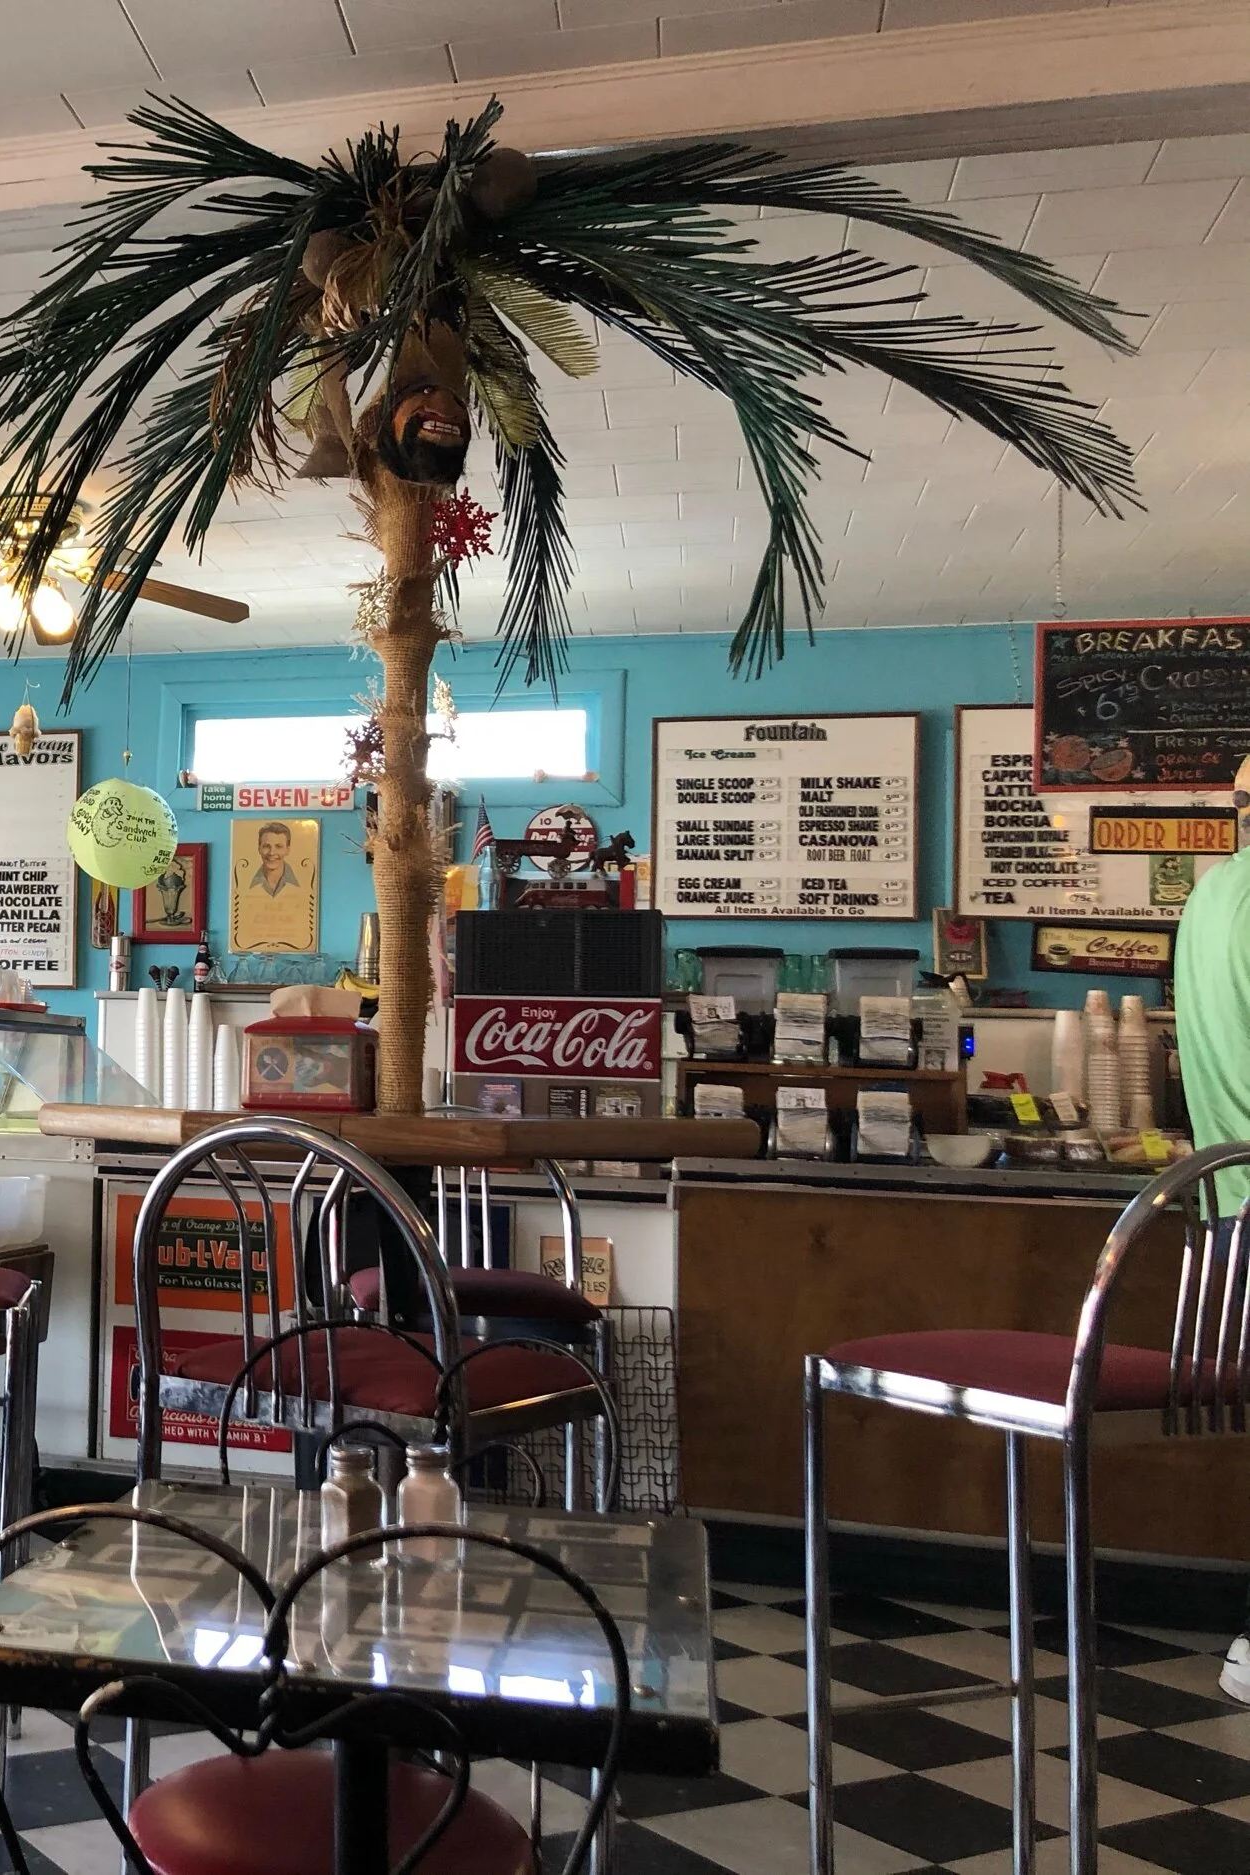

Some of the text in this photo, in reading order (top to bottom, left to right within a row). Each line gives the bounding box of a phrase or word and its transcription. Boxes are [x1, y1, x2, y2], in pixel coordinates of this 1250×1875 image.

[1076, 628, 1247, 653] BREAKFAS
[744, 722, 827, 741] Fountain
[31, 740, 75, 752] ream
[684, 749, 757, 759] Ice Cream
[991, 754, 1032, 767] ESPR
[982, 770, 1032, 782] CAPPUC
[203, 785, 226, 793] take
[676, 778, 715, 790] SINGLE
[718, 777, 754, 789] SCOOP
[800, 777, 832, 789] MILK
[837, 777, 881, 789] SHAKE
[203, 793, 232, 801] home
[238, 788, 351, 808] SEVEN-UP
[678, 792, 718, 803] DOUBLE
[721, 792, 755, 803] SCOOP
[800, 791, 834, 802] MALT
[799, 805, 814, 817] OLD
[815, 805, 857, 817] FASHIONED
[858, 806, 878, 818] SODA
[984, 800, 1044, 812] MOCHA
[540, 817, 552, 826] 10
[676, 820, 709, 832] SMALL
[713, 820, 754, 832] SUNDAE
[799, 820, 845, 832] ESPRESSO
[848, 820, 879, 832] SHAKE
[984, 815, 1051, 827] BORGIA
[116, 820, 157, 838] Sandwich
[1097, 821, 1230, 849] ORDER HERE
[126, 833, 148, 844] Club
[676, 834, 710, 846] LARGE
[713, 834, 754, 845] SUNDAE
[799, 835, 878, 846] CASANOVA
[676, 849, 721, 860] BANANA
[724, 850, 754, 861] SPLIT
[807, 849, 826, 861] ROOT
[828, 849, 845, 861] BEER
[991, 862, 1012, 873] HOT
[1015, 862, 1079, 874] CHOCOLATE
[22, 871, 47, 881] CHIP
[678, 878, 741, 889] EGG CREAM
[801, 878, 825, 890] ICED
[827, 879, 848, 890] TEA
[982, 879, 1017, 887] ICED
[1022, 879, 1080, 888] COFFEE
[676, 891, 721, 903] ORANGE
[723, 892, 755, 904] JUICE
[799, 893, 829, 905] SOFT
[833, 893, 879, 905] DRINKS
[982, 891, 1015, 904] TEA
[714, 905, 865, 915] All Items Available To Go
[1027, 906, 1175, 916] All Items Available To
[27, 923, 60, 933] PECAN
[1086, 936, 1160, 957] Coffee
[521, 1007, 557, 1021] Enjoy
[465, 1007, 655, 1069] Coca-Cola
[171, 1219, 181, 1230] of
[186, 1220, 221, 1233] Orange
[225, 1221, 263, 1233] Drks
[159, 1275, 243, 1289] For Two Glasse
[187, 1427, 210, 1438] WITH
[212, 1429, 250, 1441] VAMIN
